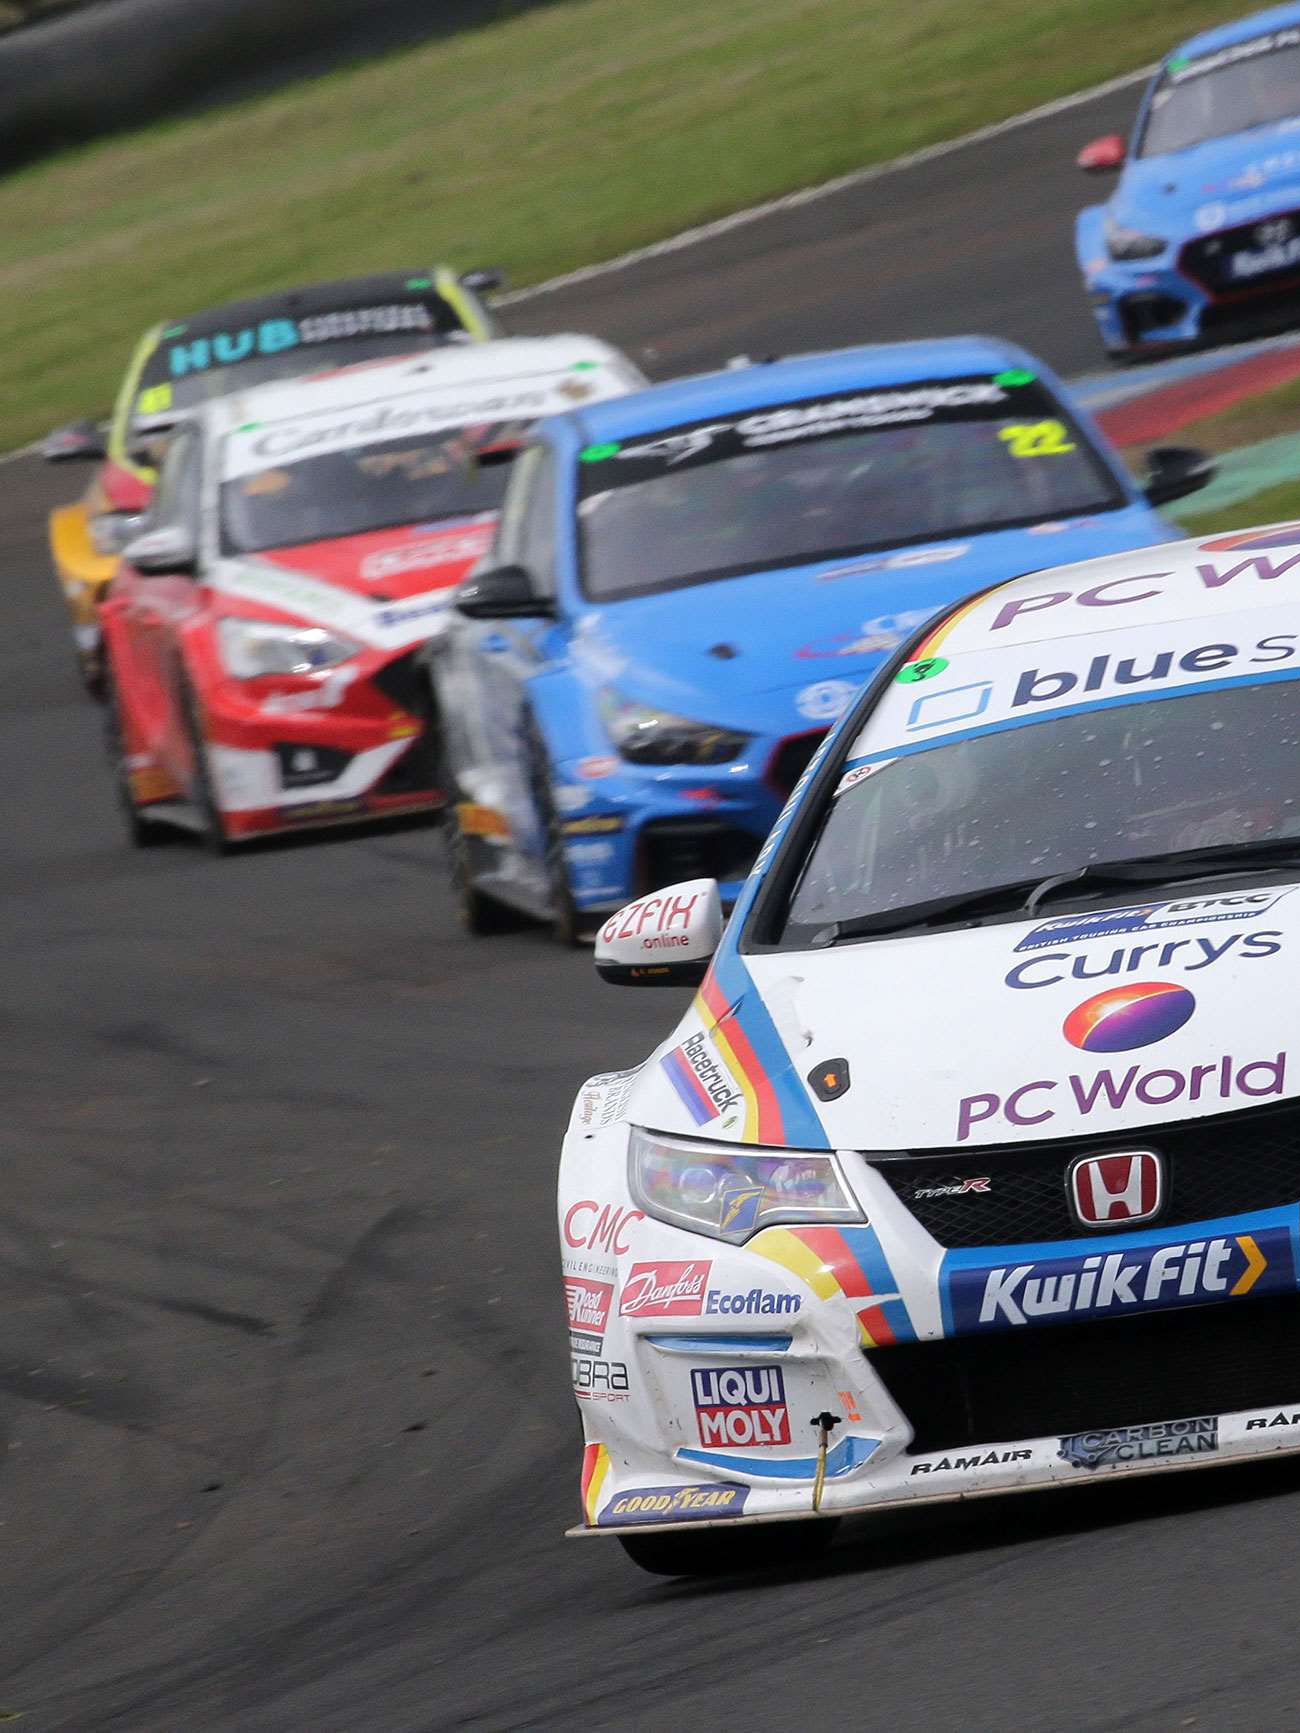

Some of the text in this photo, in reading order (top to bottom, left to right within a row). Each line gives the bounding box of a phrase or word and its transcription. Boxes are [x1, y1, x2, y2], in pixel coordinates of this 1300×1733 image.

[169, 318, 298, 376] HUB
[997, 420, 1076, 458] 22
[988, 571, 1177, 632] PC
[1168, 893, 1273, 912] BTCC
[1019, 937, 1069, 951] BRITISH
[1072, 927, 1127, 941] TOURING
[1160, 911, 1257, 928] CHAMPIONSHIP
[1004, 930, 1284, 990] Currys
[681, 1031, 744, 1113] Racetruck
[956, 1051, 1287, 1142] PC World
[564, 1200, 646, 1255] CMC
[621, 1264, 705, 1313] Danfoss
[705, 1289, 801, 1314] Ecoflam
[694, 1369, 780, 1406] LIQUI
[700, 1408, 787, 1445] MOLY
[1083, 1417, 1215, 1449] CARBON
[1117, 1433, 1217, 1460] CLEAN
[612, 1488, 736, 1514] GOODYEAR
